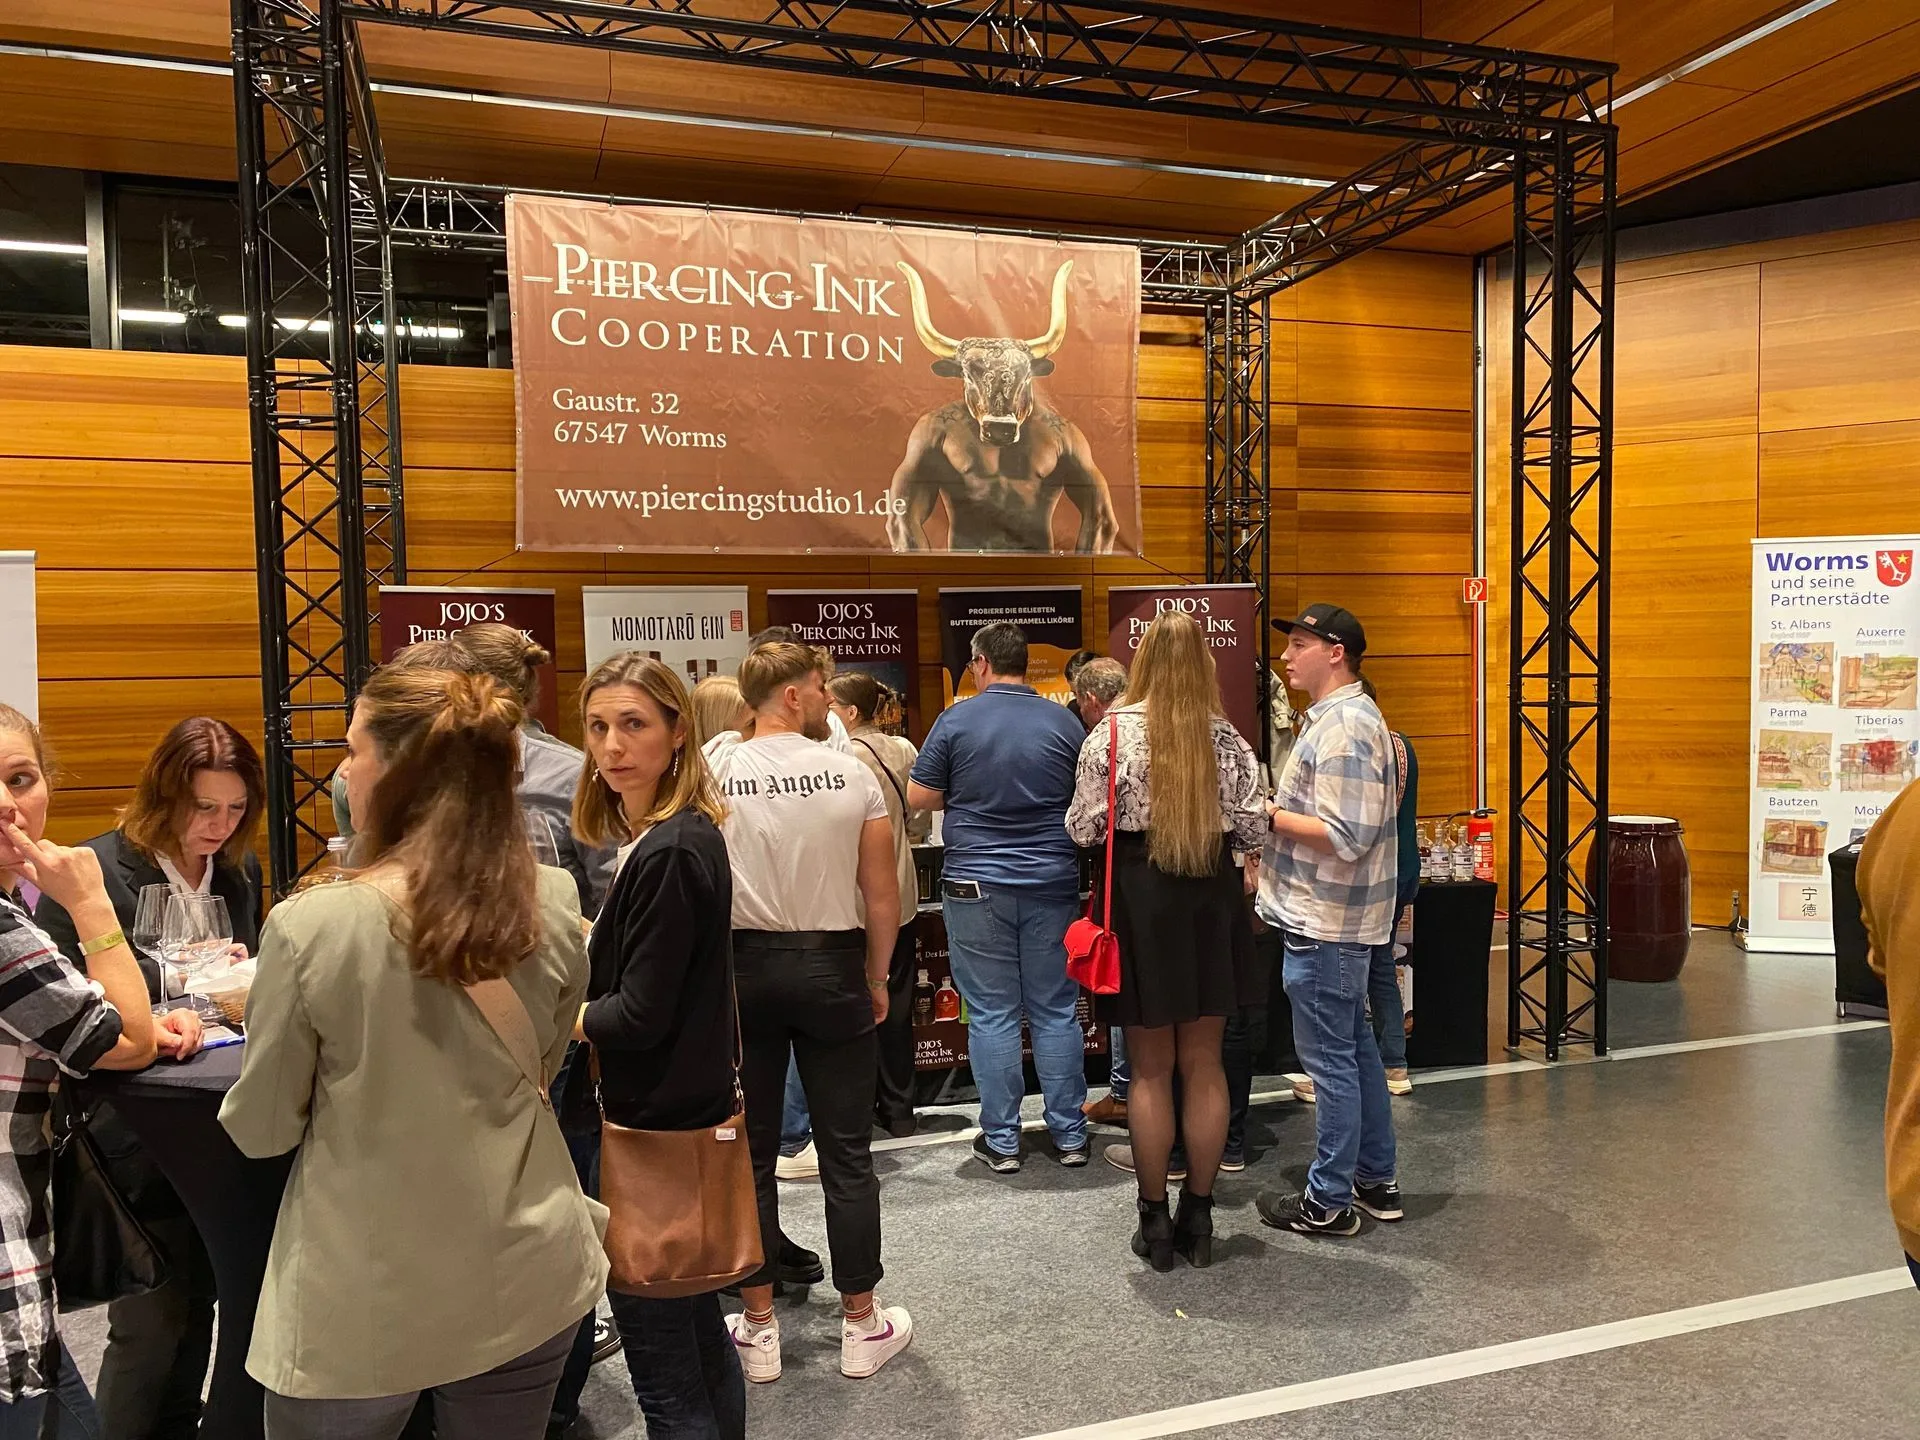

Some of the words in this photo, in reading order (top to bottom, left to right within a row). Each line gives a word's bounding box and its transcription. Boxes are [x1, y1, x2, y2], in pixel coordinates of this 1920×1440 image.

[553, 388, 641, 413] Gaustr.
[651, 393, 680, 414] 32
[554, 421, 628, 444] 67547
[639, 424, 727, 448] Worms
[555, 484, 907, 520] www.piercingstudio1.de
[1766, 552, 1869, 571] Worms
[1771, 576, 1804, 589] und
[1810, 575, 1855, 588] seine
[1771, 592, 1890, 606] Partnerstädte
[968, 607, 1004, 615] PROBIERE
[701, 616, 724, 640] GIN
[1771, 620, 1786, 630] St.
[1790, 619, 1832, 629] Albans
[1856, 627, 1906, 637] Auxerre
[829, 644, 902, 656] PERATION
[1770, 708, 1807, 717] Parma
[1856, 715, 1904, 725] Tiberias
[764, 770, 846, 799] Angels
[1769, 797, 1818, 806] Bautzen
